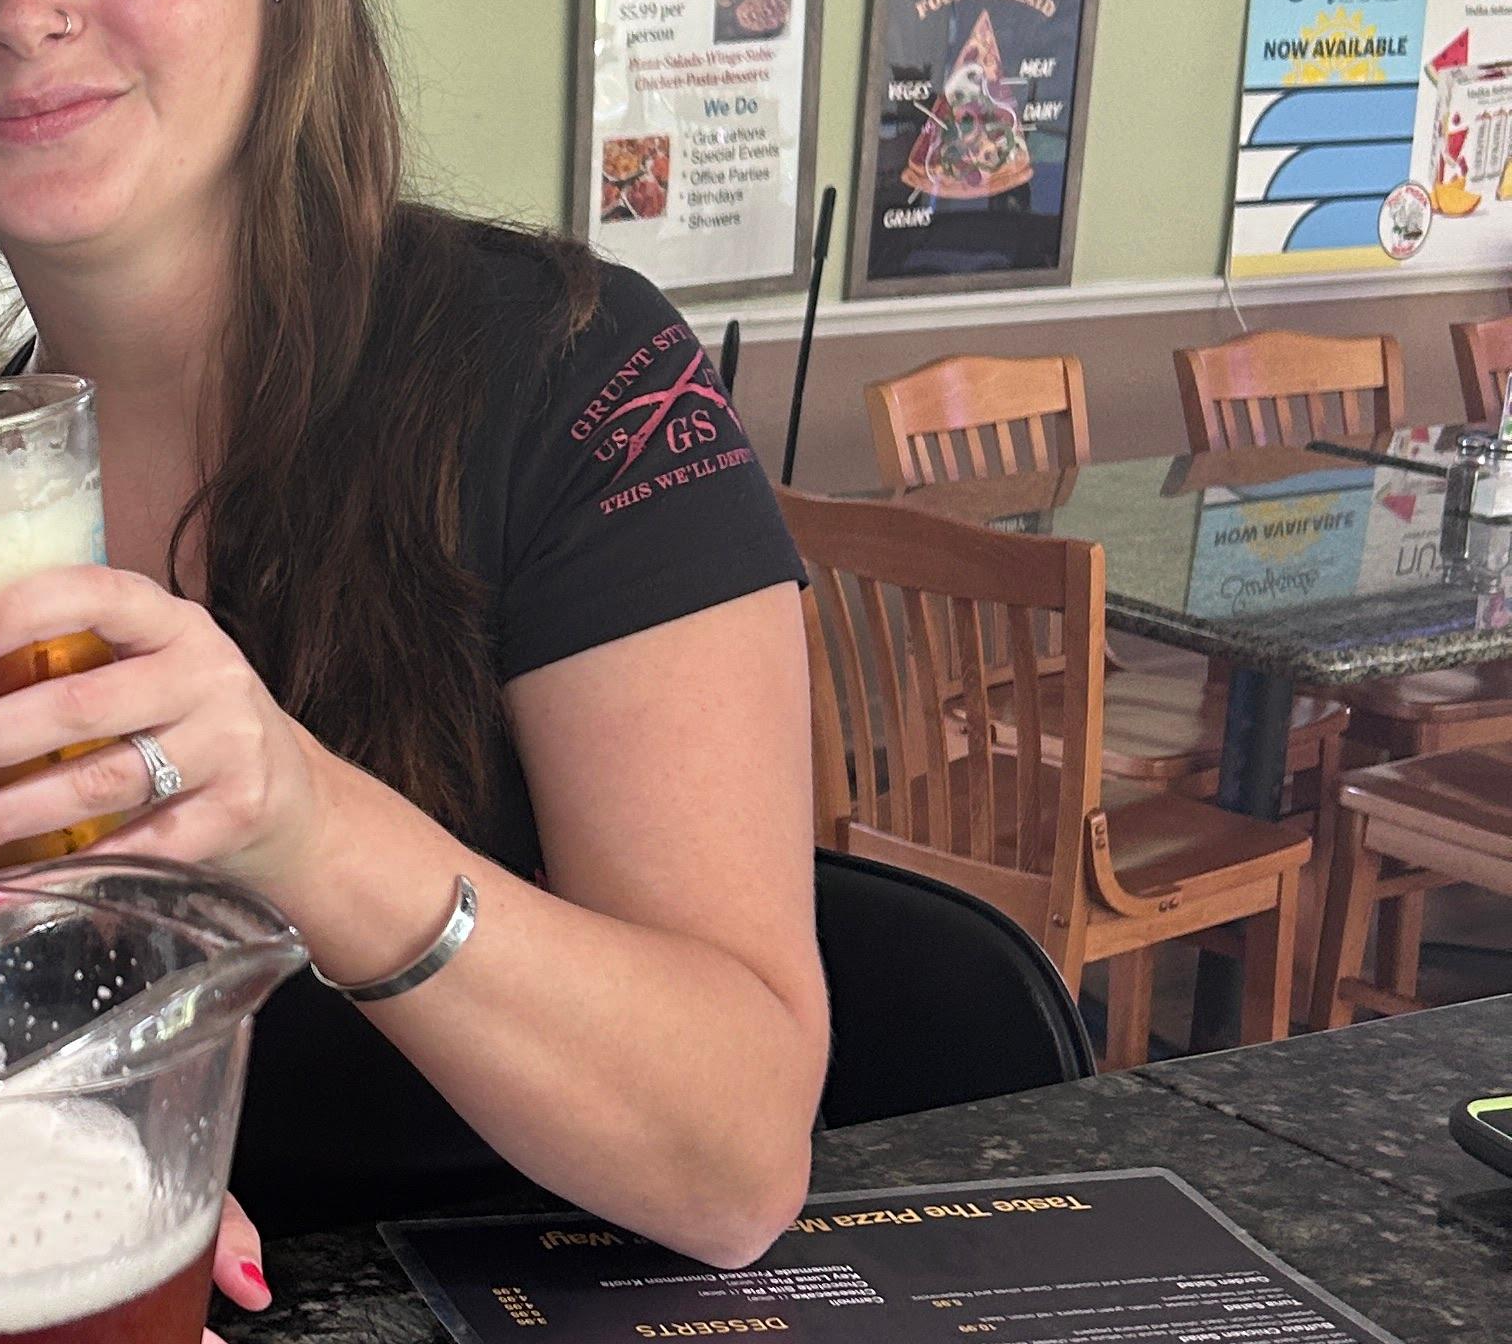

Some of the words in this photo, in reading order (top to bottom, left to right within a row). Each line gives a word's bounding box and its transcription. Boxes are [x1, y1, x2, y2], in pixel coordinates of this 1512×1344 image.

[1263, 37, 1310, 61] NOW
[1312, 33, 1409, 59] AVAILABLE
[704, 97, 729, 118] We
[735, 96, 758, 115] Do
[691, 145, 735, 165] Special
[570, 347, 655, 441] GRUNT
[665, 408, 718, 454] GS
[594, 426, 629, 463] US
[599, 481, 655, 516] THIS
[654, 455, 717, 490] WE'LL
[923, 1203, 992, 1218] The
[992, 1196, 1092, 1212] Taste
[833, 1208, 922, 1227] Pizza
[539, 1231, 623, 1249] Way!
[636, 1317, 788, 1337] DESSERTS
